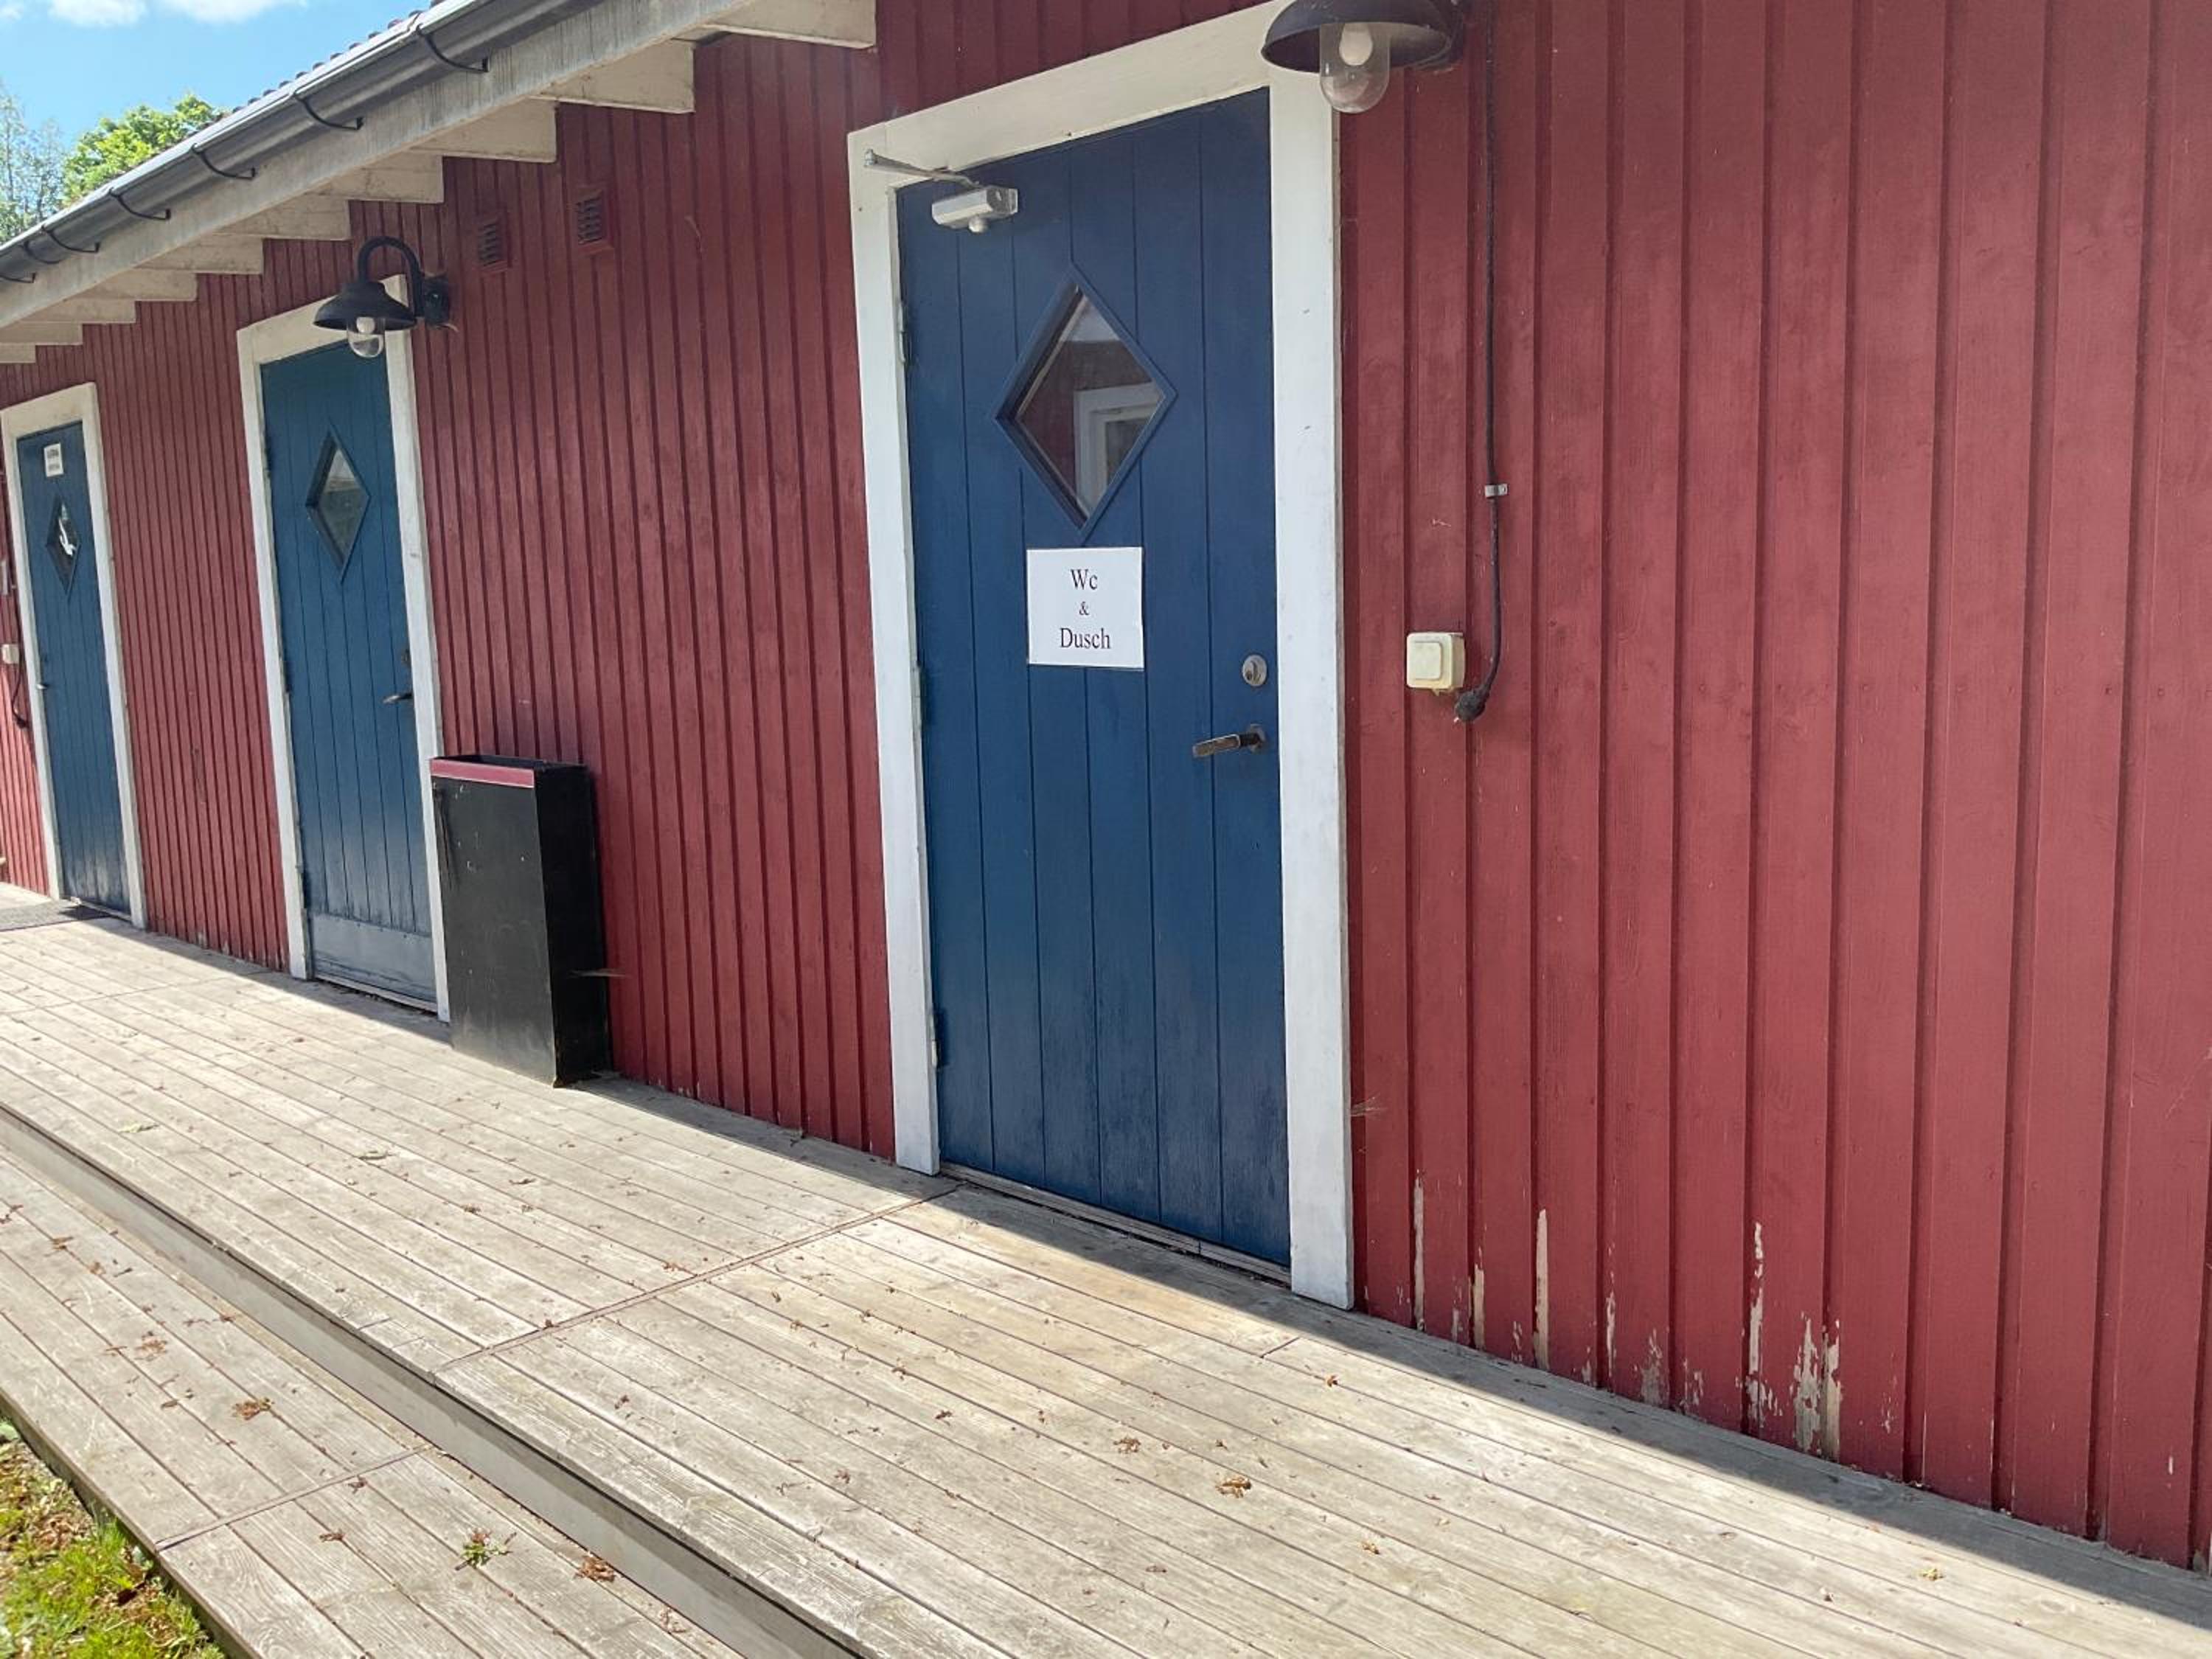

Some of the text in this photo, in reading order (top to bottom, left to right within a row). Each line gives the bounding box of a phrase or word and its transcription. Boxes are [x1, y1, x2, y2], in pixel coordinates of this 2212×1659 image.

[1070, 568, 1098, 591] Wc
[1079, 601, 1090, 616] &
[1060, 627, 1111, 650] Dusch
